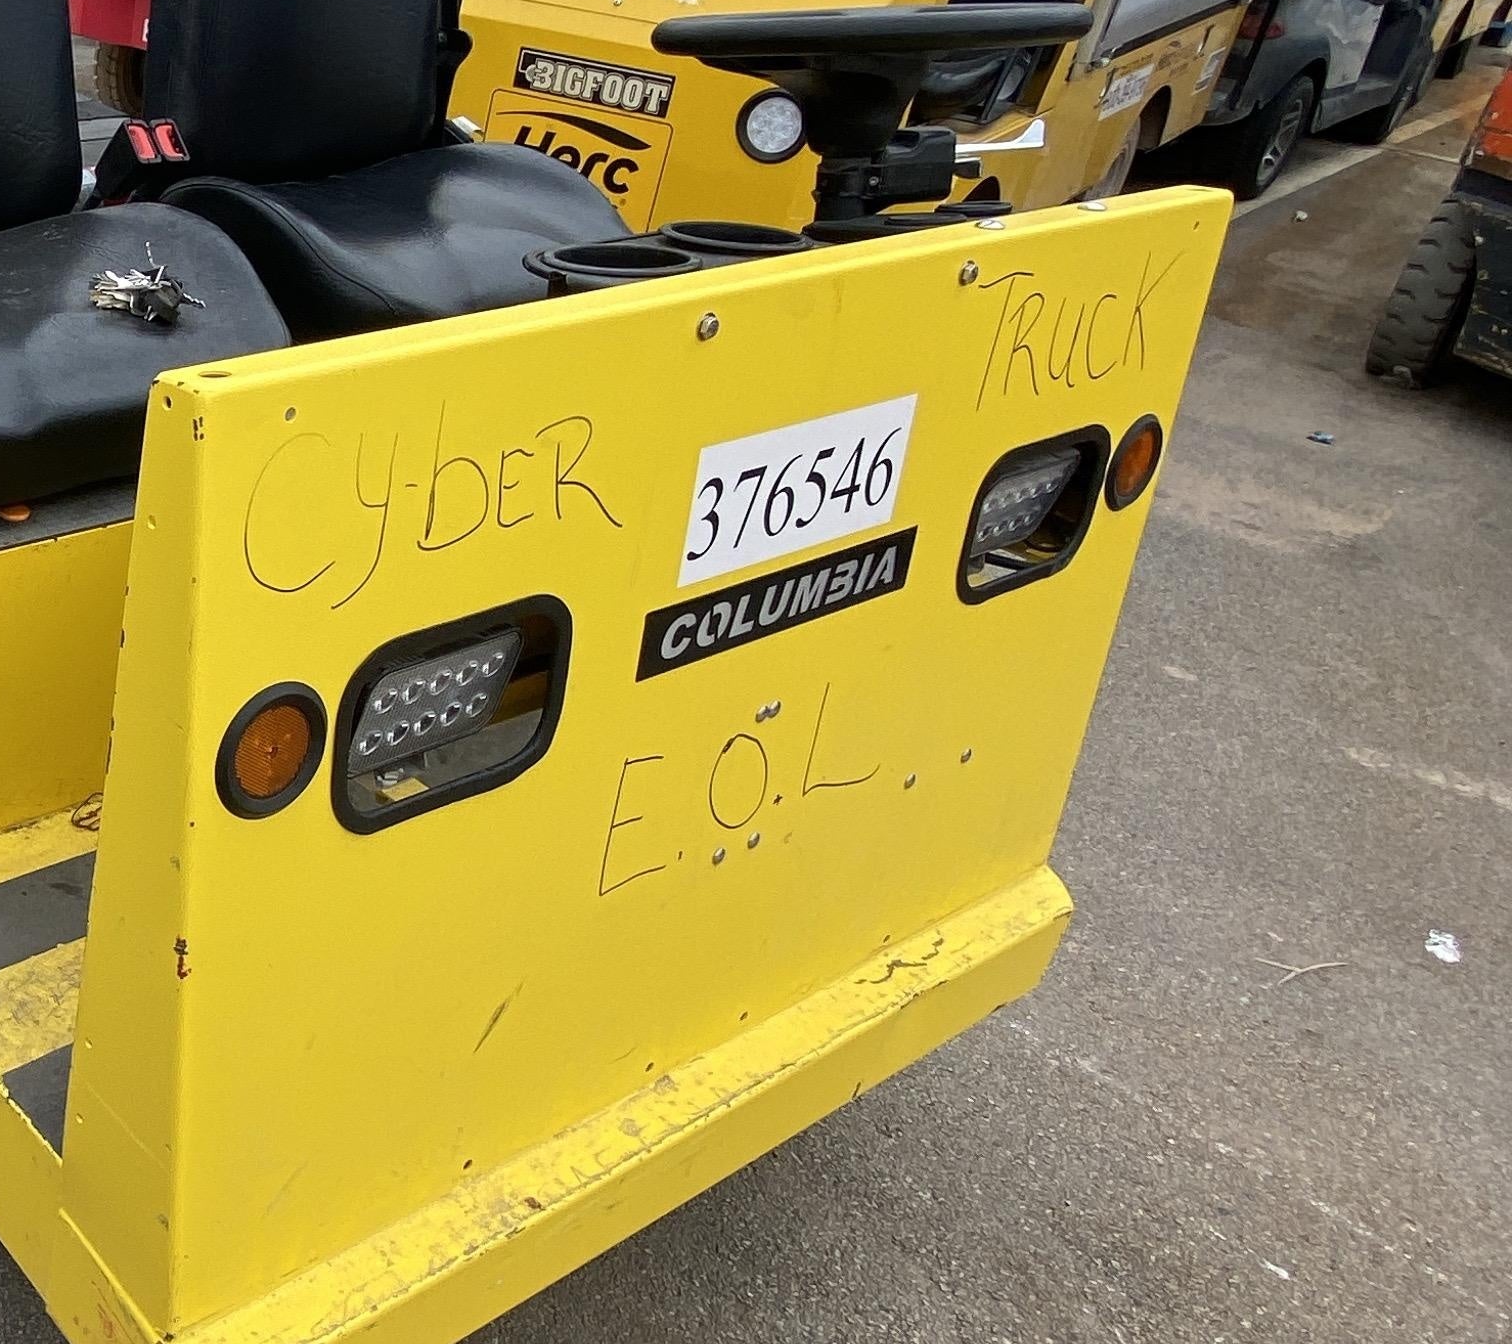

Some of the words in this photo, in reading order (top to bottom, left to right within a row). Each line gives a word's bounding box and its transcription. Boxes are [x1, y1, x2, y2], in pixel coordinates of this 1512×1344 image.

[530, 58, 671, 113] BIGFOOT
[978, 249, 1185, 412] TRUCK
[686, 427, 902, 561] 376546
[660, 545, 899, 660] COLUMBIA
